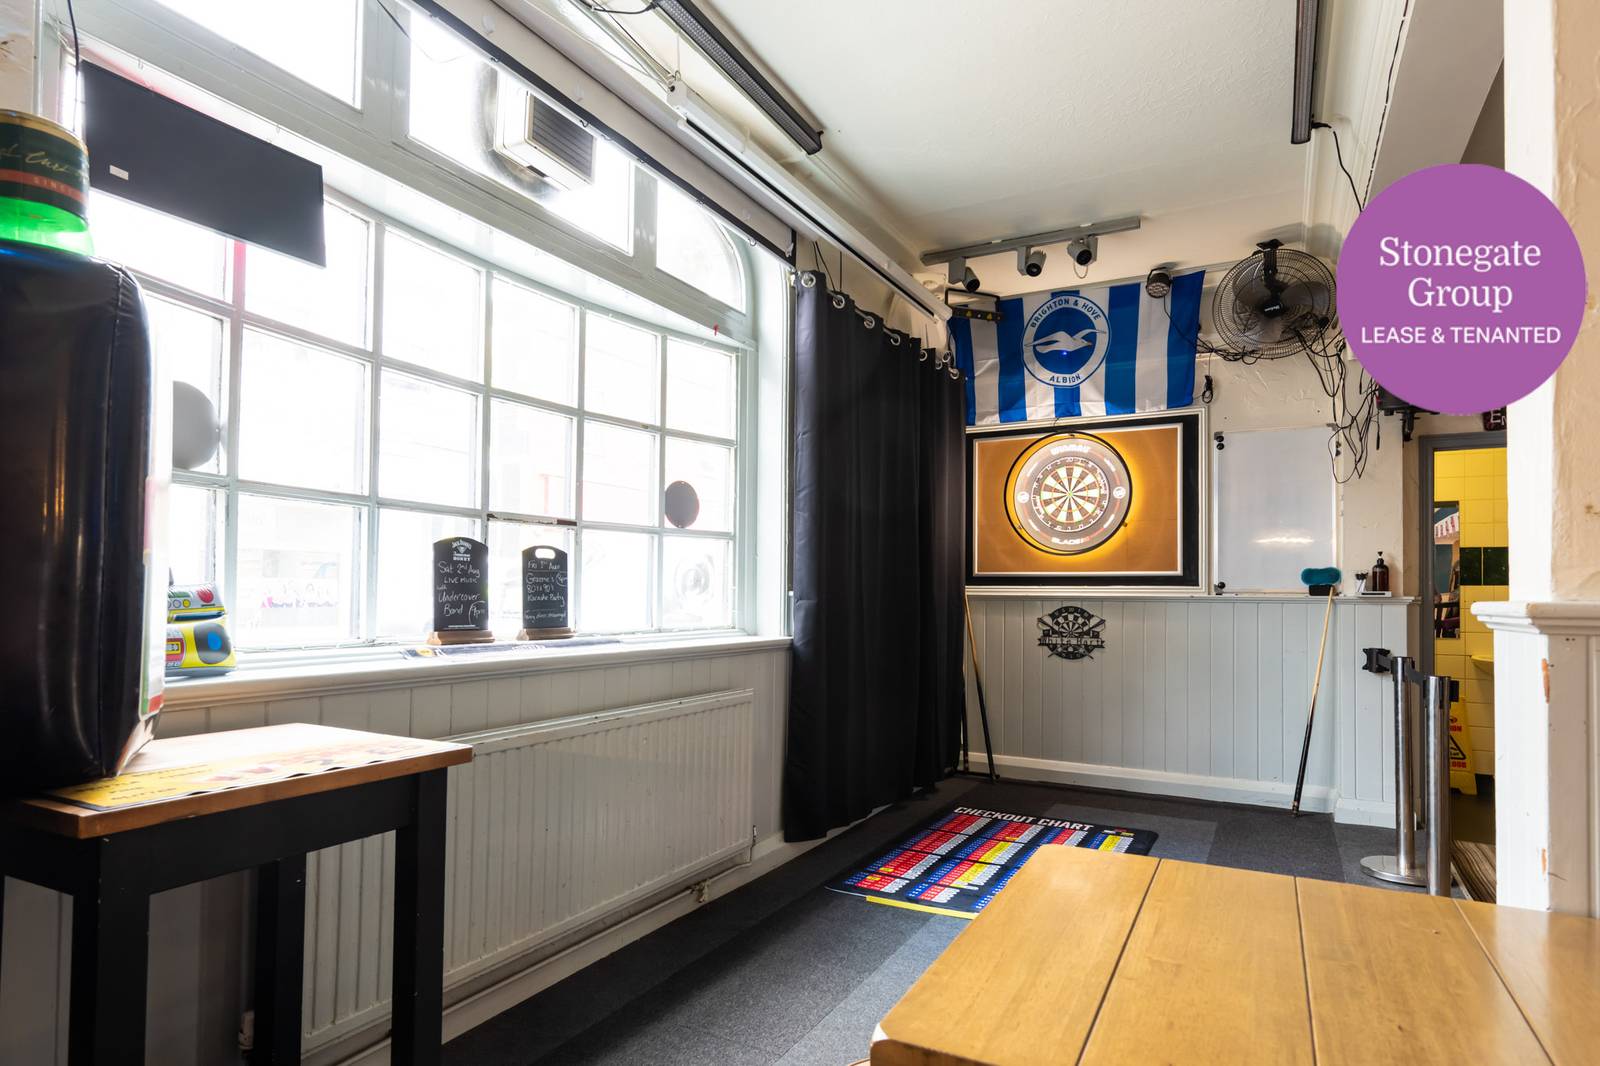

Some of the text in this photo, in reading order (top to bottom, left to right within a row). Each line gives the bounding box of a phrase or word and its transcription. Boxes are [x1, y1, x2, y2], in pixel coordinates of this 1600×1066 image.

[1030, 298, 1070, 328] BRIGHTON
[1081, 302, 1101, 321] HOVE
[1049, 373, 1081, 384] ALBION
[438, 561, 453, 574] Sat
[468, 564, 480, 578] Aug
[438, 591, 480, 603] Undercover
[443, 603, 464, 616] Band
[954, 806, 1094, 831] CHECKOUT CHART
